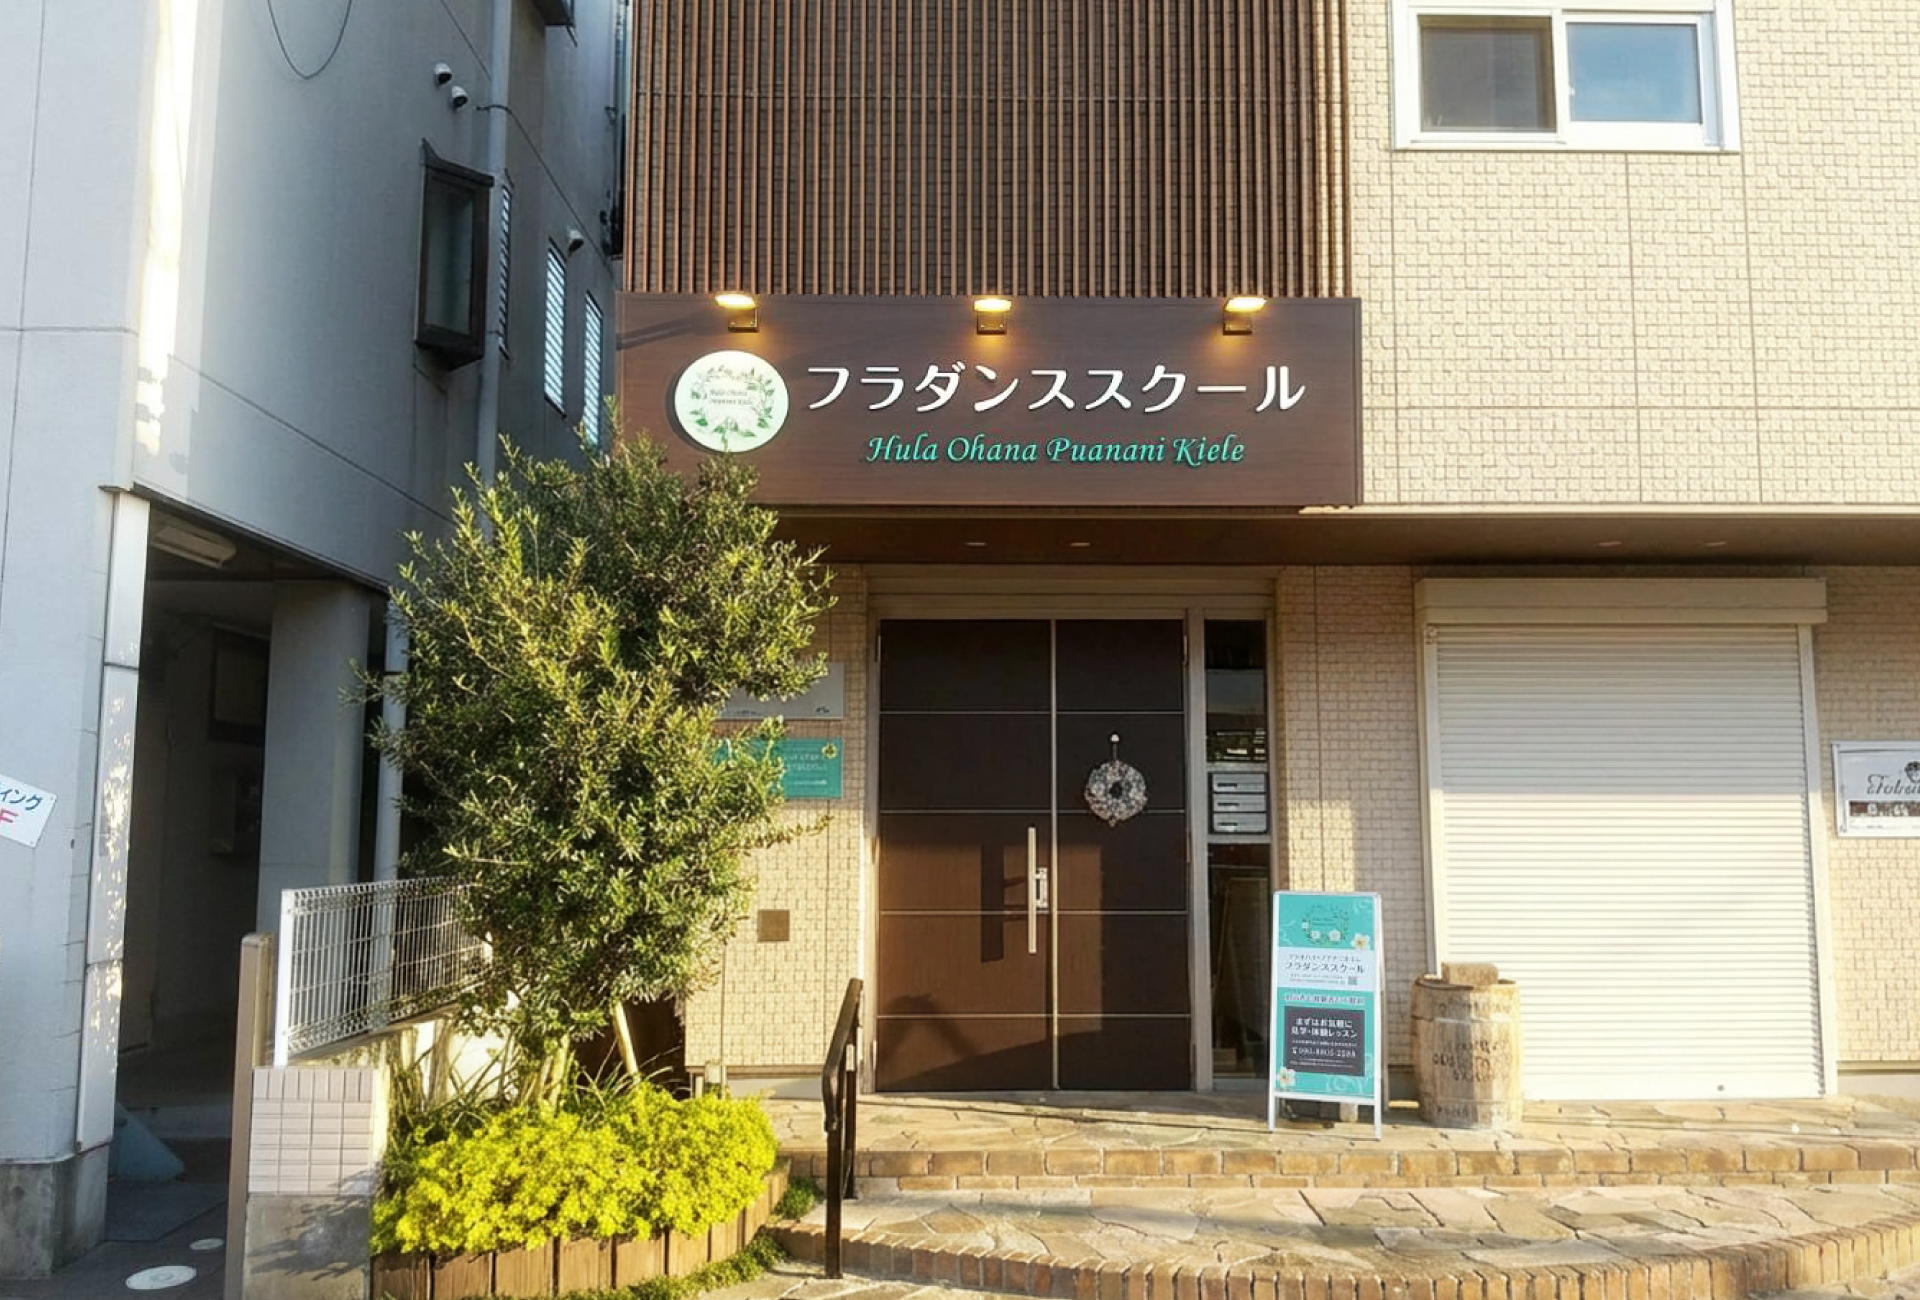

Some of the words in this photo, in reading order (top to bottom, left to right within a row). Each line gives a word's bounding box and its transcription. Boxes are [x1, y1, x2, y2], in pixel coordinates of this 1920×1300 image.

[807, 361, 1306, 413] フラダンススクール
[866, 433, 938, 462] Hula
[947, 434, 1038, 462] Ohana
[1046, 437, 1166, 463] Puanani
[1173, 434, 1245, 468] Kiele
[1285, 961, 1364, 974] フラダンススクール
